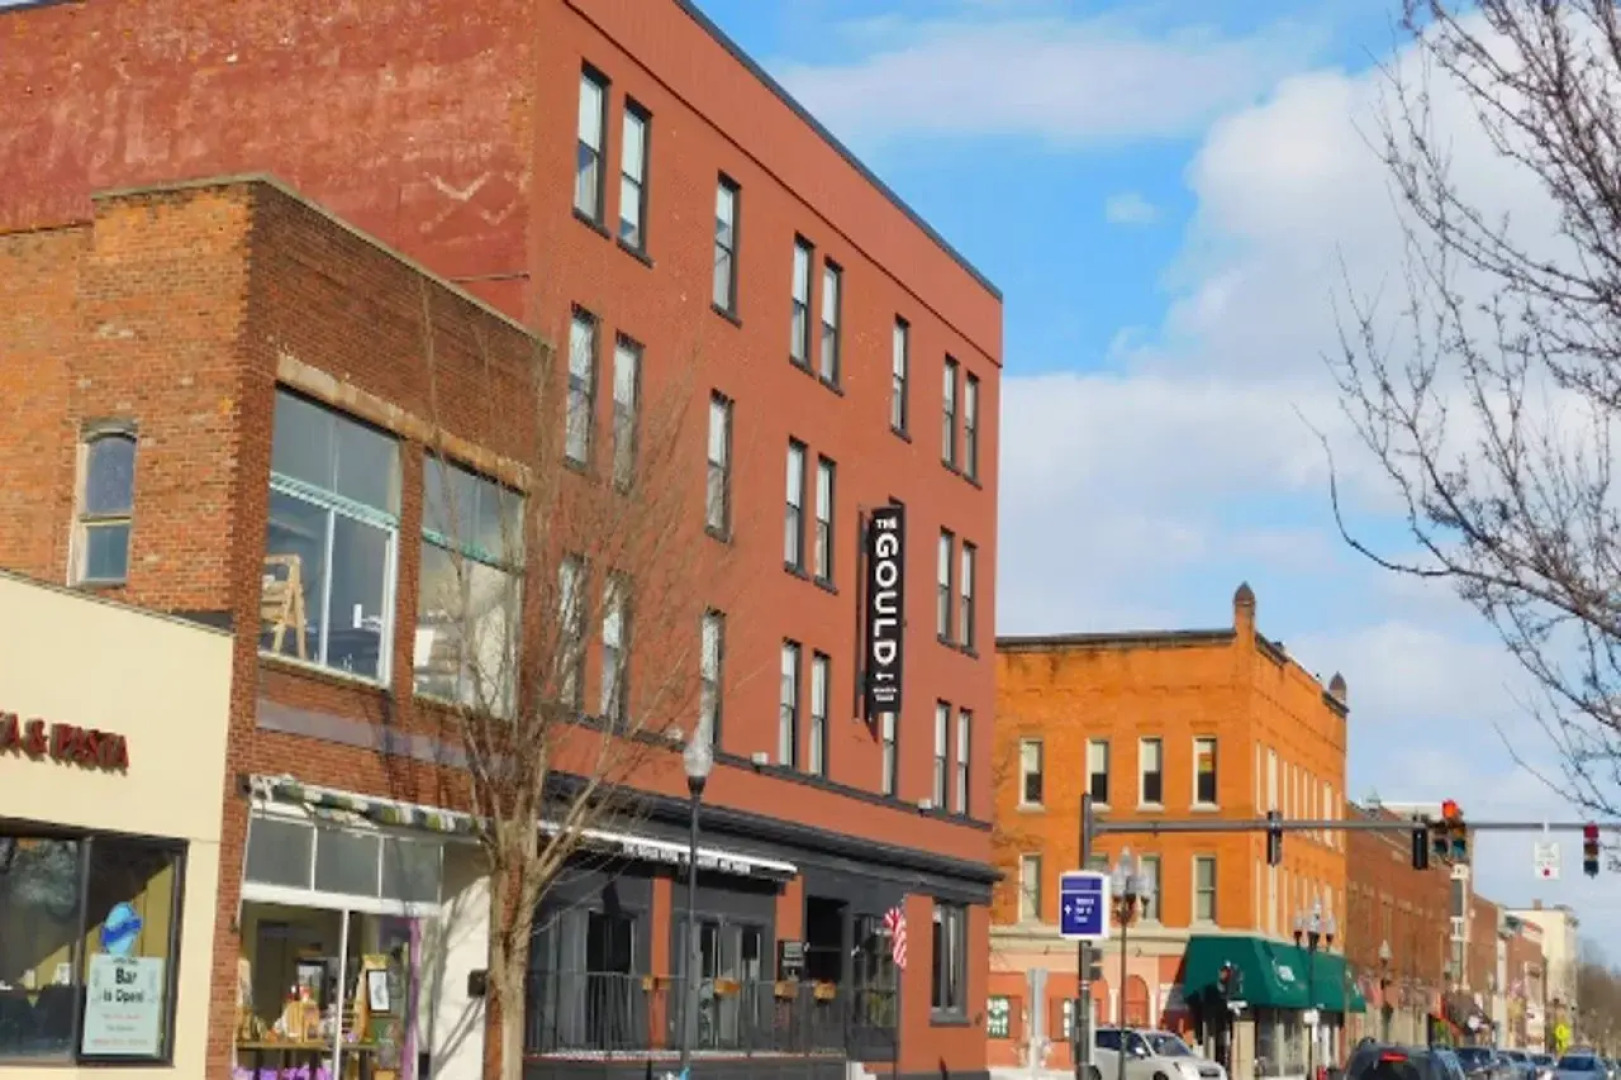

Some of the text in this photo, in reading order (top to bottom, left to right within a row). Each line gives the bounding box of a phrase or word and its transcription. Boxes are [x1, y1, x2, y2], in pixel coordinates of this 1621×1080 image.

[874, 532, 898, 666] GOULD
[0, 709, 129, 776] A & PASTA
[115, 967, 137, 984] Bar
